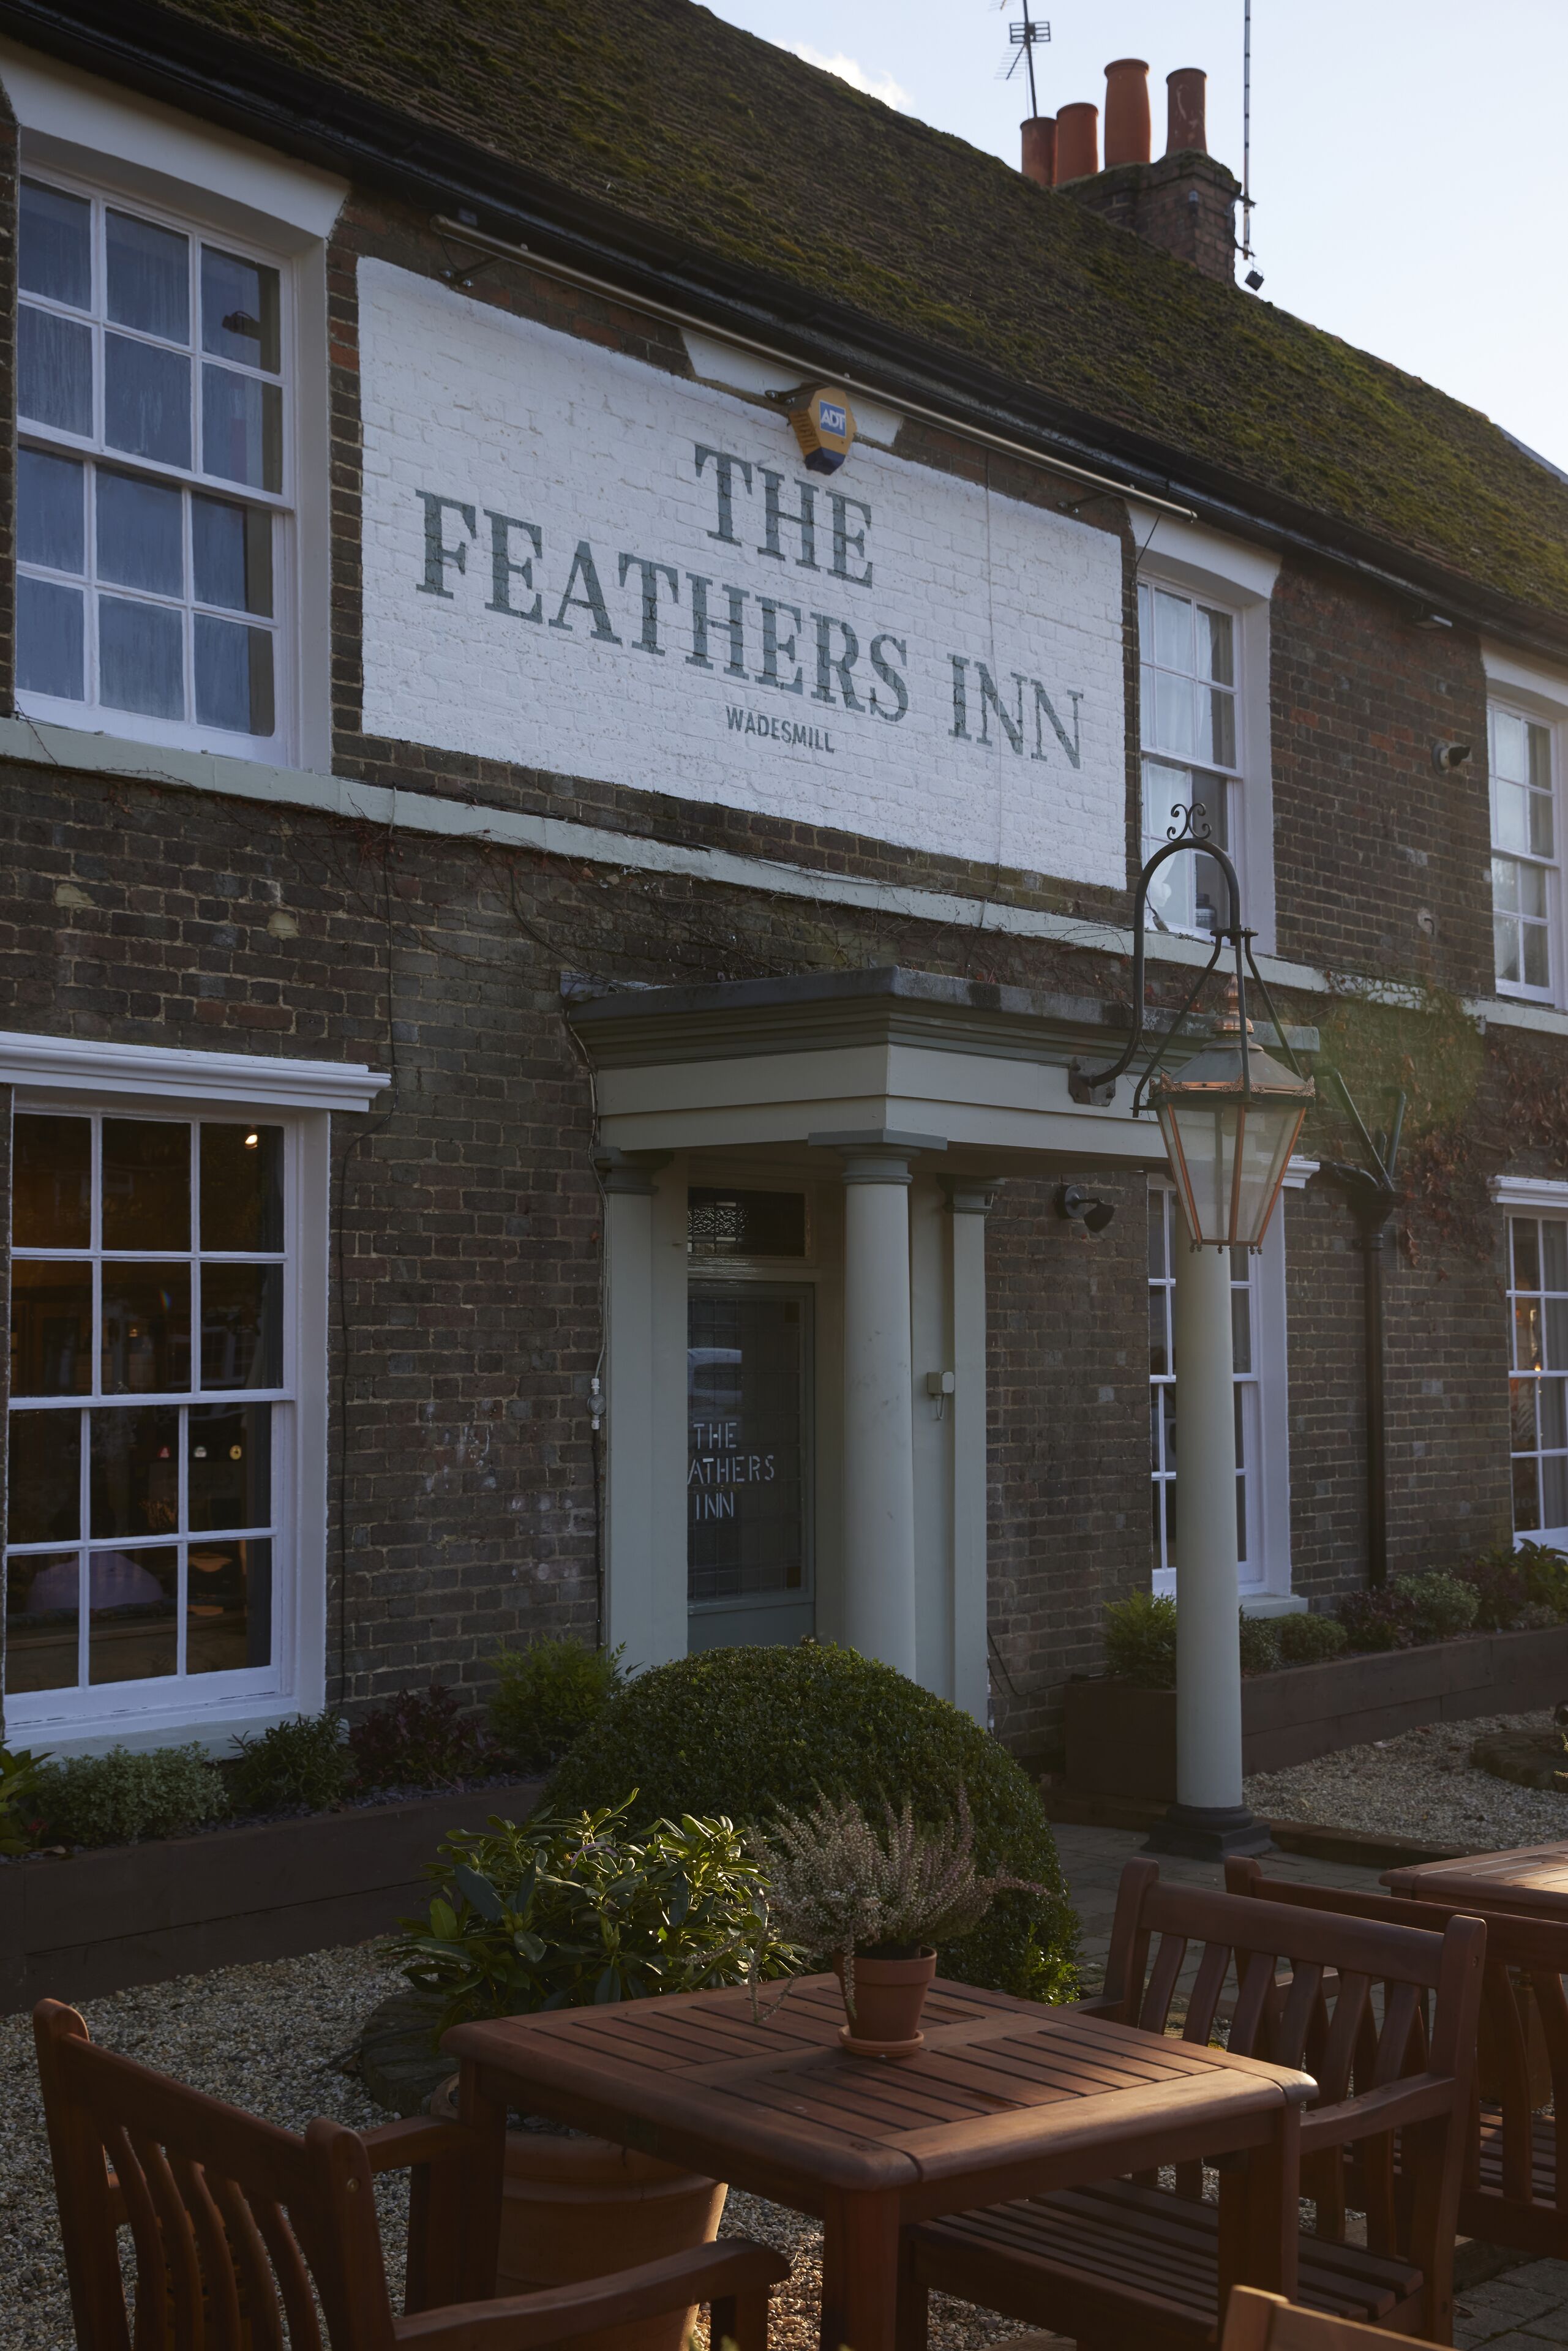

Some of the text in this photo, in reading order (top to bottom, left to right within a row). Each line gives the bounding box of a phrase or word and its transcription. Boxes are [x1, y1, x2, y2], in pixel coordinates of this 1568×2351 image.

[820, 408, 846, 430] ADT
[694, 443, 873, 589] THE
[415, 489, 1084, 770] FEATHERS INN
[726, 705, 835, 754] WADESMILL
[693, 1422, 737, 1449] THE
[688, 1455, 775, 1485] ATHERS
[696, 1491, 734, 1520] INN
